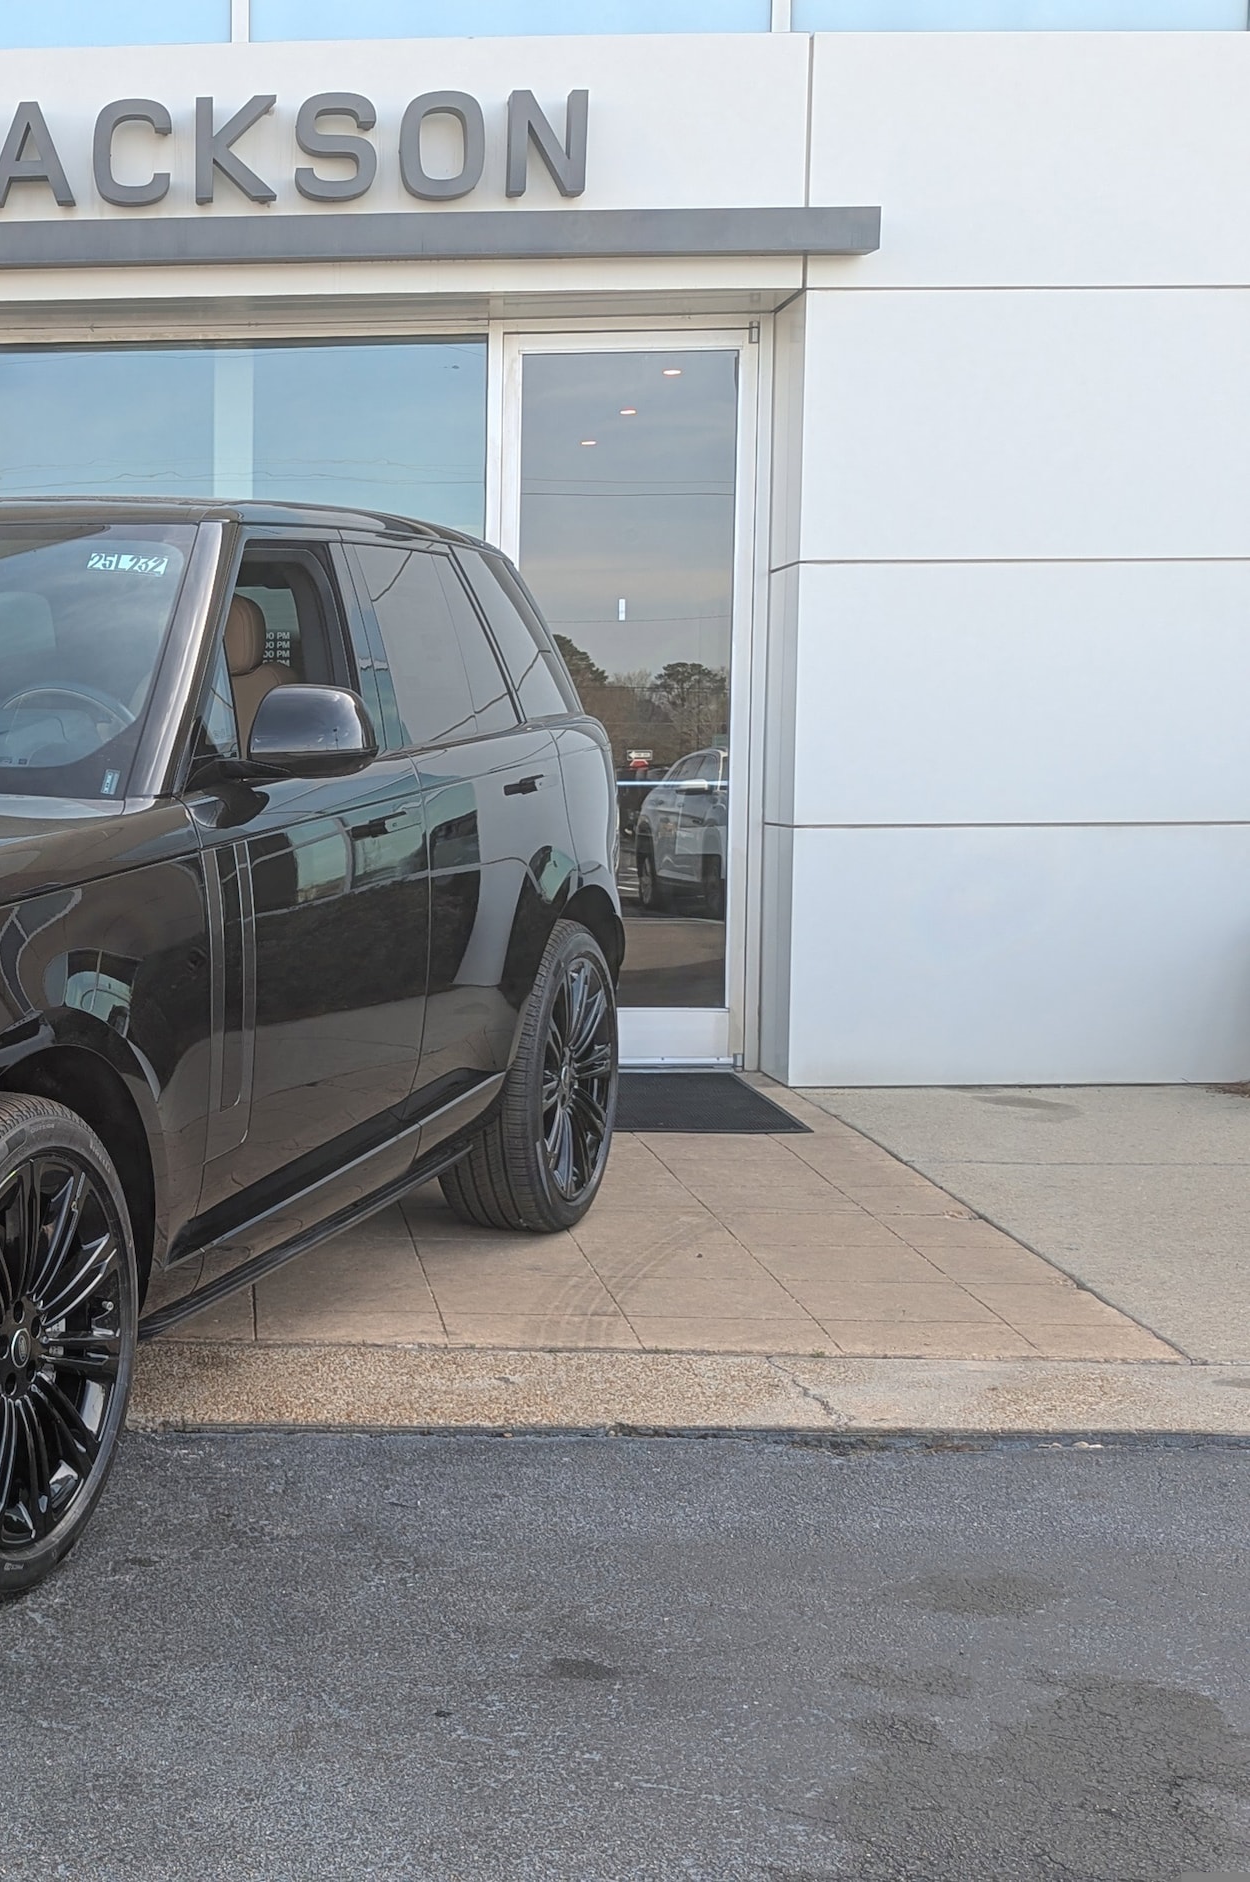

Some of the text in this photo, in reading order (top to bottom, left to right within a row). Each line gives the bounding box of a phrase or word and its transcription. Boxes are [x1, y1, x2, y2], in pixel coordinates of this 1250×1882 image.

[276, 632, 290, 640] PM
[276, 641, 290, 649] PM
[276, 650, 290, 658] PM
